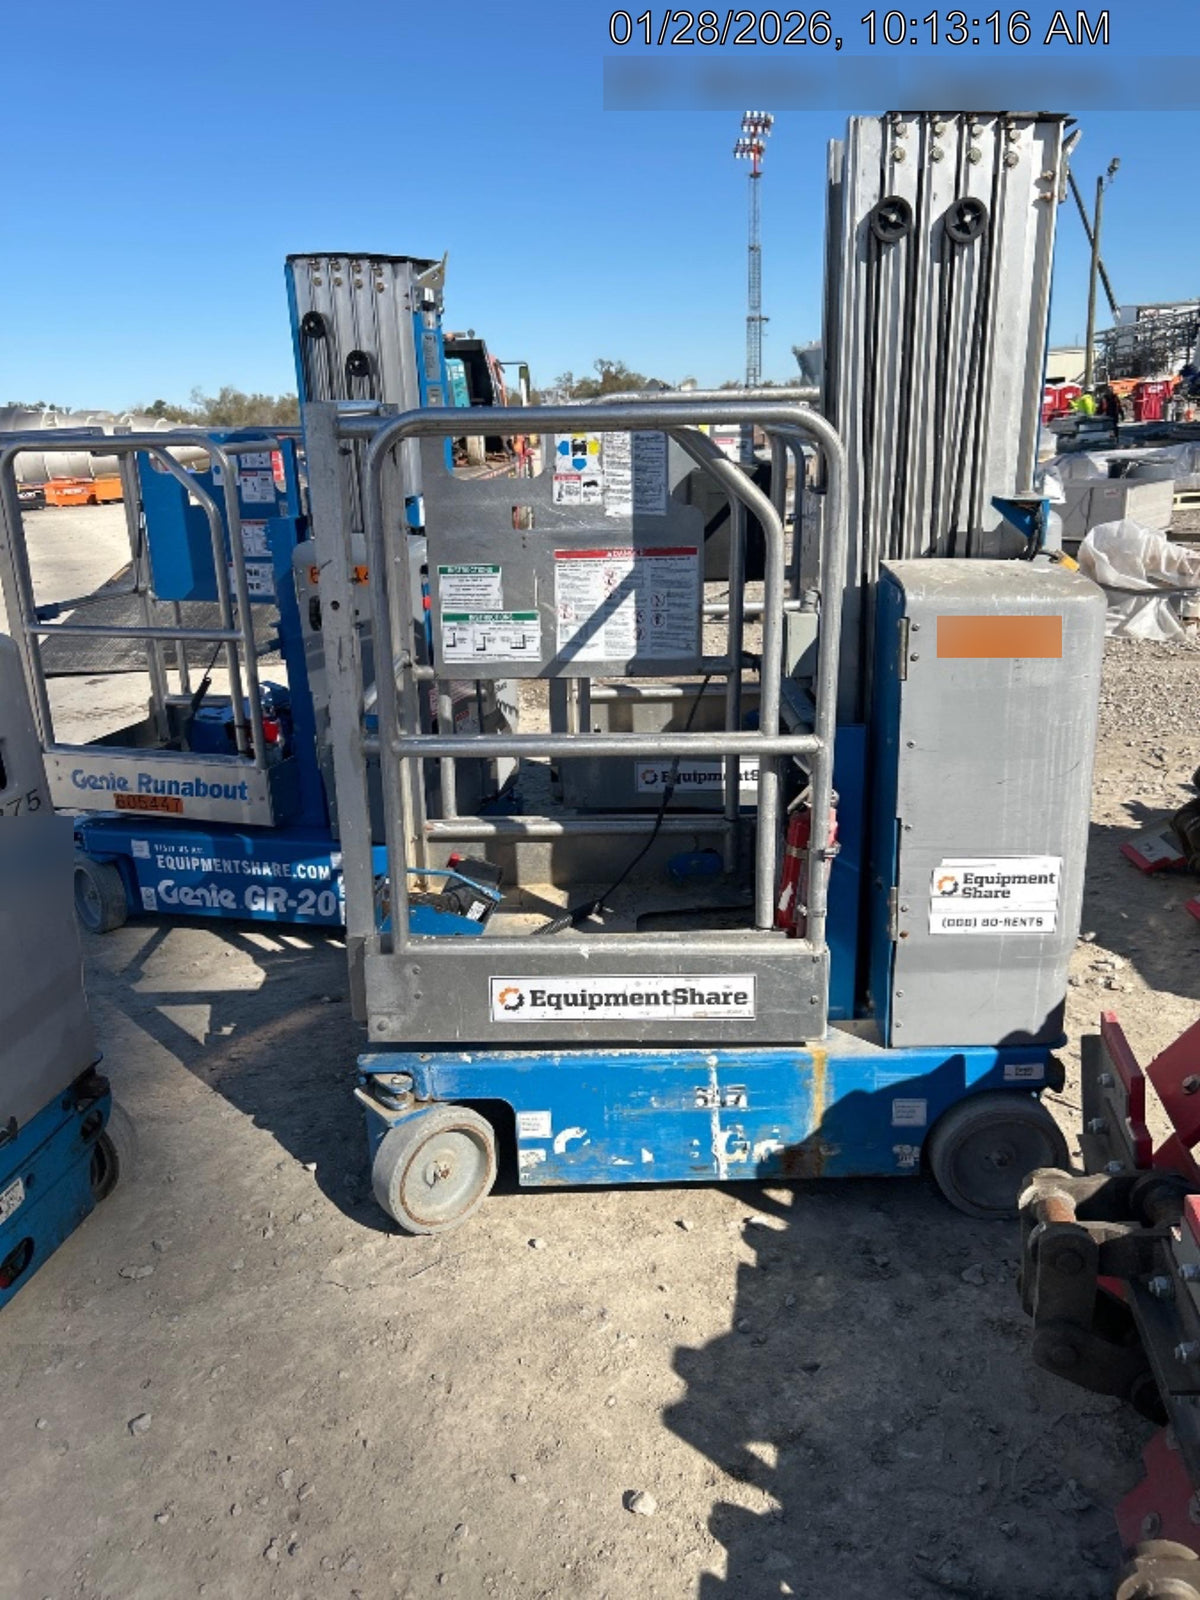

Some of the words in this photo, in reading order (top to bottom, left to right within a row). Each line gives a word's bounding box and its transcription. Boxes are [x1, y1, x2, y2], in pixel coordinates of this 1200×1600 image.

[71, 769, 129, 791] Genie
[137, 773, 248, 800] Runabout
[157, 855, 331, 880] EQUIPMENTSHARE.COM
[963, 872, 1056, 888] Equipment
[158, 879, 237, 910] Genie
[245, 885, 337, 917] GR-20
[961, 886, 1011, 899] Share
[529, 987, 748, 1010] EquipmentShare
